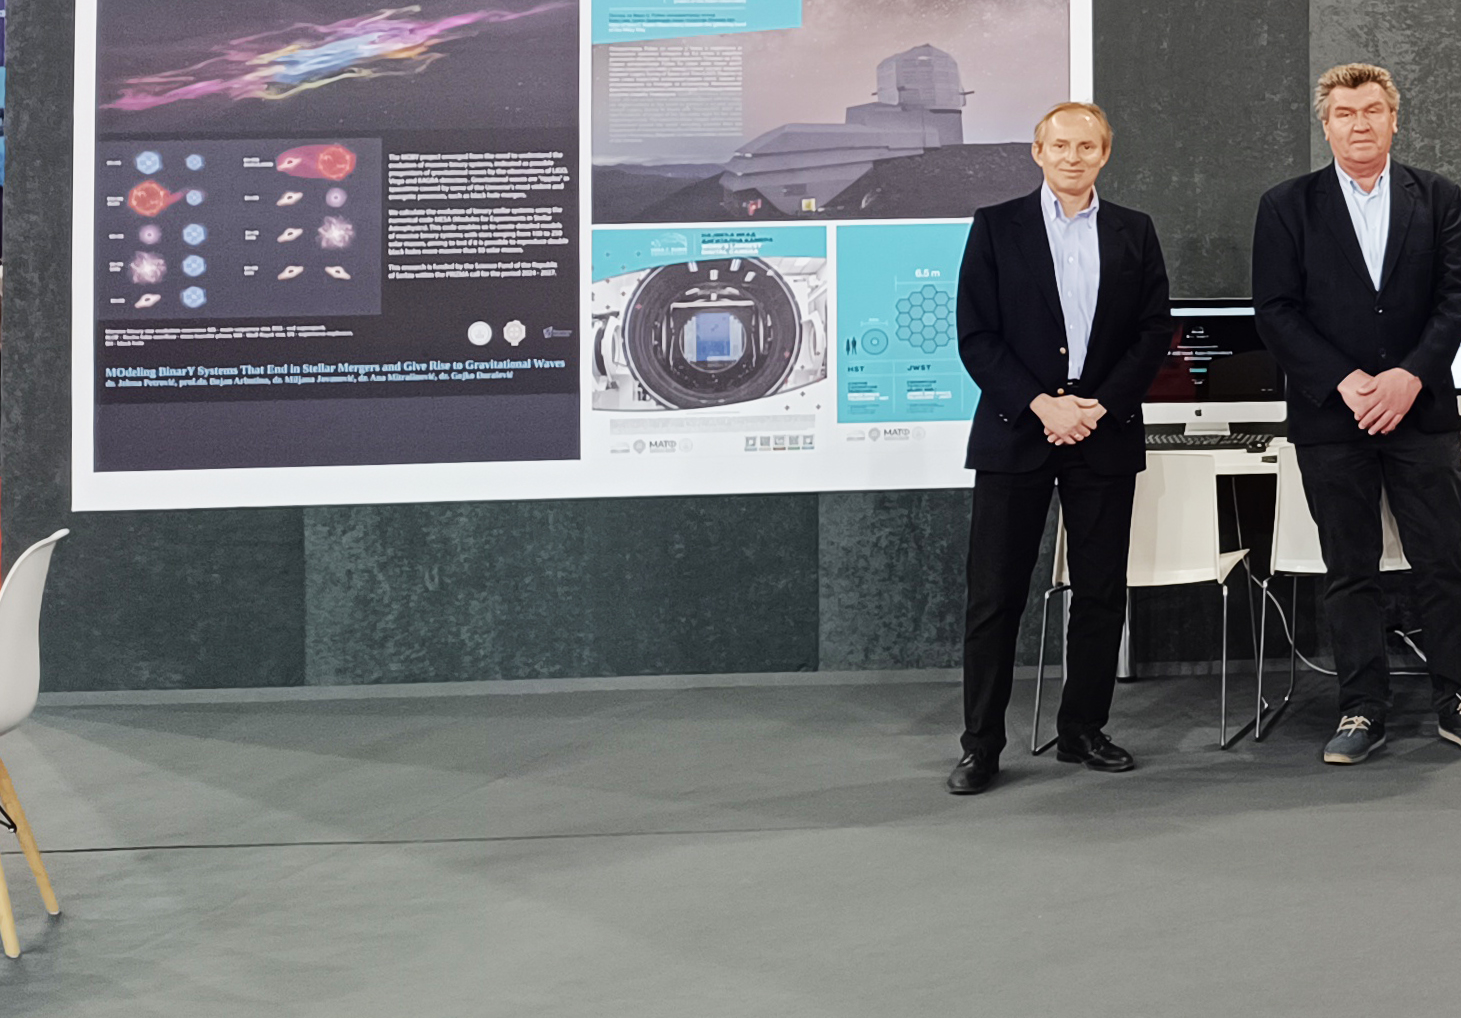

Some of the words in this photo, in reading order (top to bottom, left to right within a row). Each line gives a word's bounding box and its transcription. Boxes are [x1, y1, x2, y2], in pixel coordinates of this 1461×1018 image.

[931, 270, 941, 278] m
[105, 368, 157, 379] MOdeling
[158, 366, 195, 377] BinarY
[198, 366, 238, 378] Systems
[240, 364, 265, 375] That
[267, 364, 288, 374] End
[302, 363, 336, 374] Stellar
[338, 362, 380, 375] Mergers
[382, 361, 401, 372] and
[403, 361, 428, 372] Give
[429, 360, 451, 371] Rise
[452, 361, 464, 370] to
[465, 358, 532, 370] Gravitational
[533, 358, 566, 368] Waves
[907, 364, 932, 372] JWST
